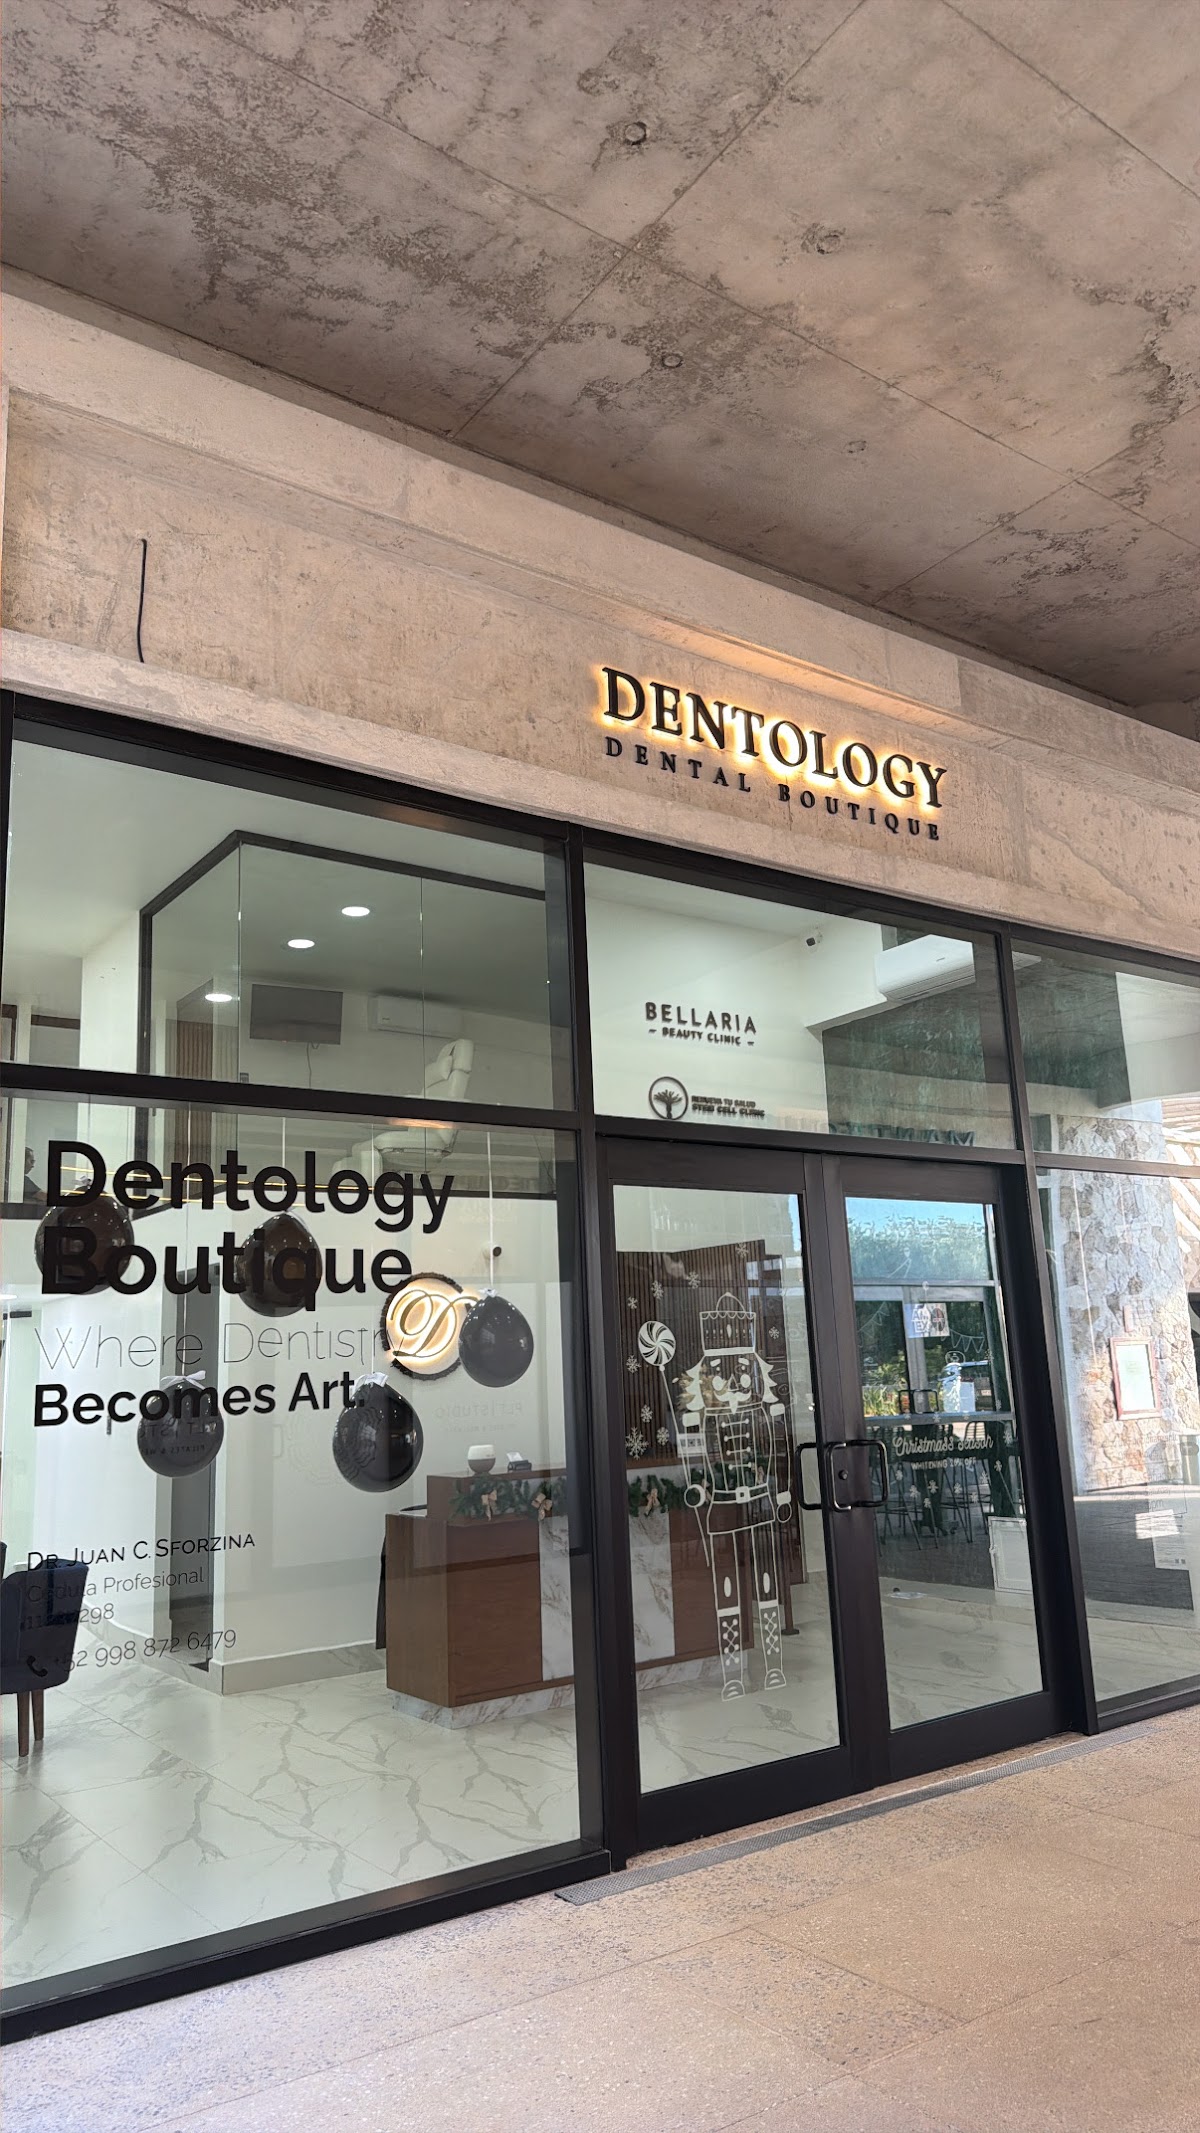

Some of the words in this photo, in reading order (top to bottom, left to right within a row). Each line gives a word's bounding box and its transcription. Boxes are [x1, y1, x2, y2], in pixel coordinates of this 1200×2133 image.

[602, 667, 947, 808] DENTOLOGY
[605, 736, 751, 792] DENTAL
[778, 784, 940, 841] BOUTIQUE
[645, 1002, 757, 1034] BELLARIA
[662, 1027, 703, 1041] BEAUTY
[707, 1033, 741, 1046] CLINIC
[46, 1139, 455, 1234] Dentology
[41, 1225, 412, 1312] Boutique
[34, 1324, 204, 1369] Where
[34, 1383, 276, 1427] Becomes
[288, 1371, 365, 1412] Art.
[911, 1459, 948, 1471] WHITENING
[103, 1566, 205, 1594] Profesional
[95, 1640, 136, 1669] 998
[143, 1637, 180, 1658] 872
[187, 1628, 236, 1652] 6479
